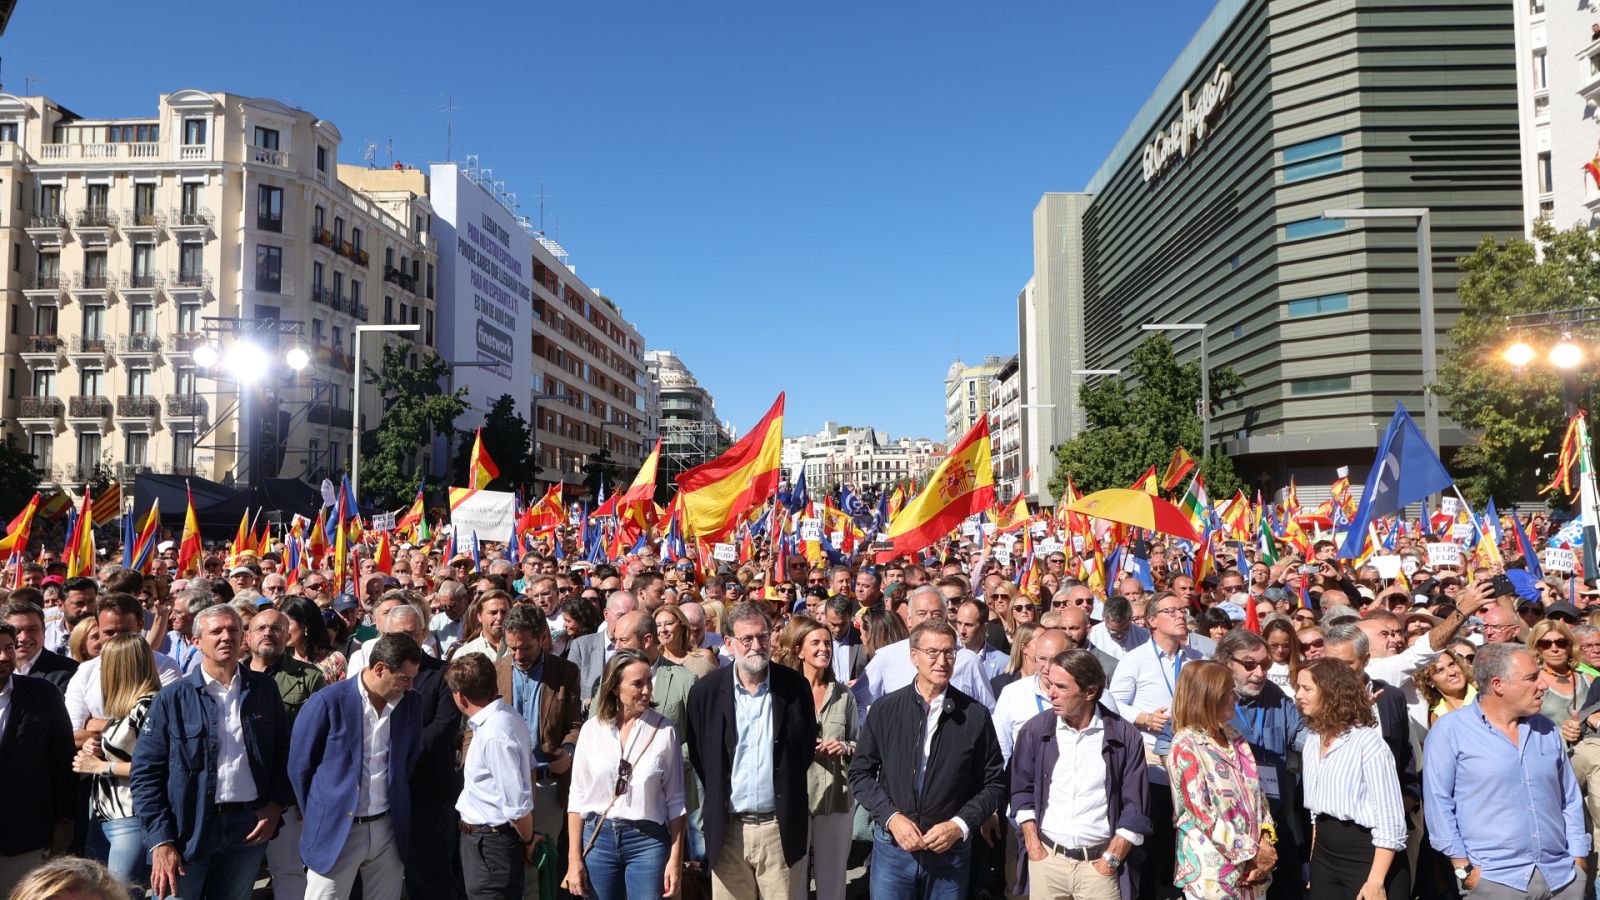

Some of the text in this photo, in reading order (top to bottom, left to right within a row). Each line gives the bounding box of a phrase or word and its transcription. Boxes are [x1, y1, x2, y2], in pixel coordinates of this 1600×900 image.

[467, 222, 479, 247] PARA
[480, 231, 487, 251] NO
[482, 212, 510, 249] LLEGAR TARDE
[458, 236, 477, 265] PORQUE
[476, 250, 491, 276] SABES
[491, 261, 499, 280] QUE
[519, 282, 530, 302] TARDE
[471, 268, 482, 291] PARA
[483, 276, 489, 296] NO
[475, 293, 480, 312] ES
[481, 297, 489, 317] TAN
[489, 302, 495, 320] DE
[505, 311, 516, 333] COMO
[478, 324, 512, 358] finetwork
